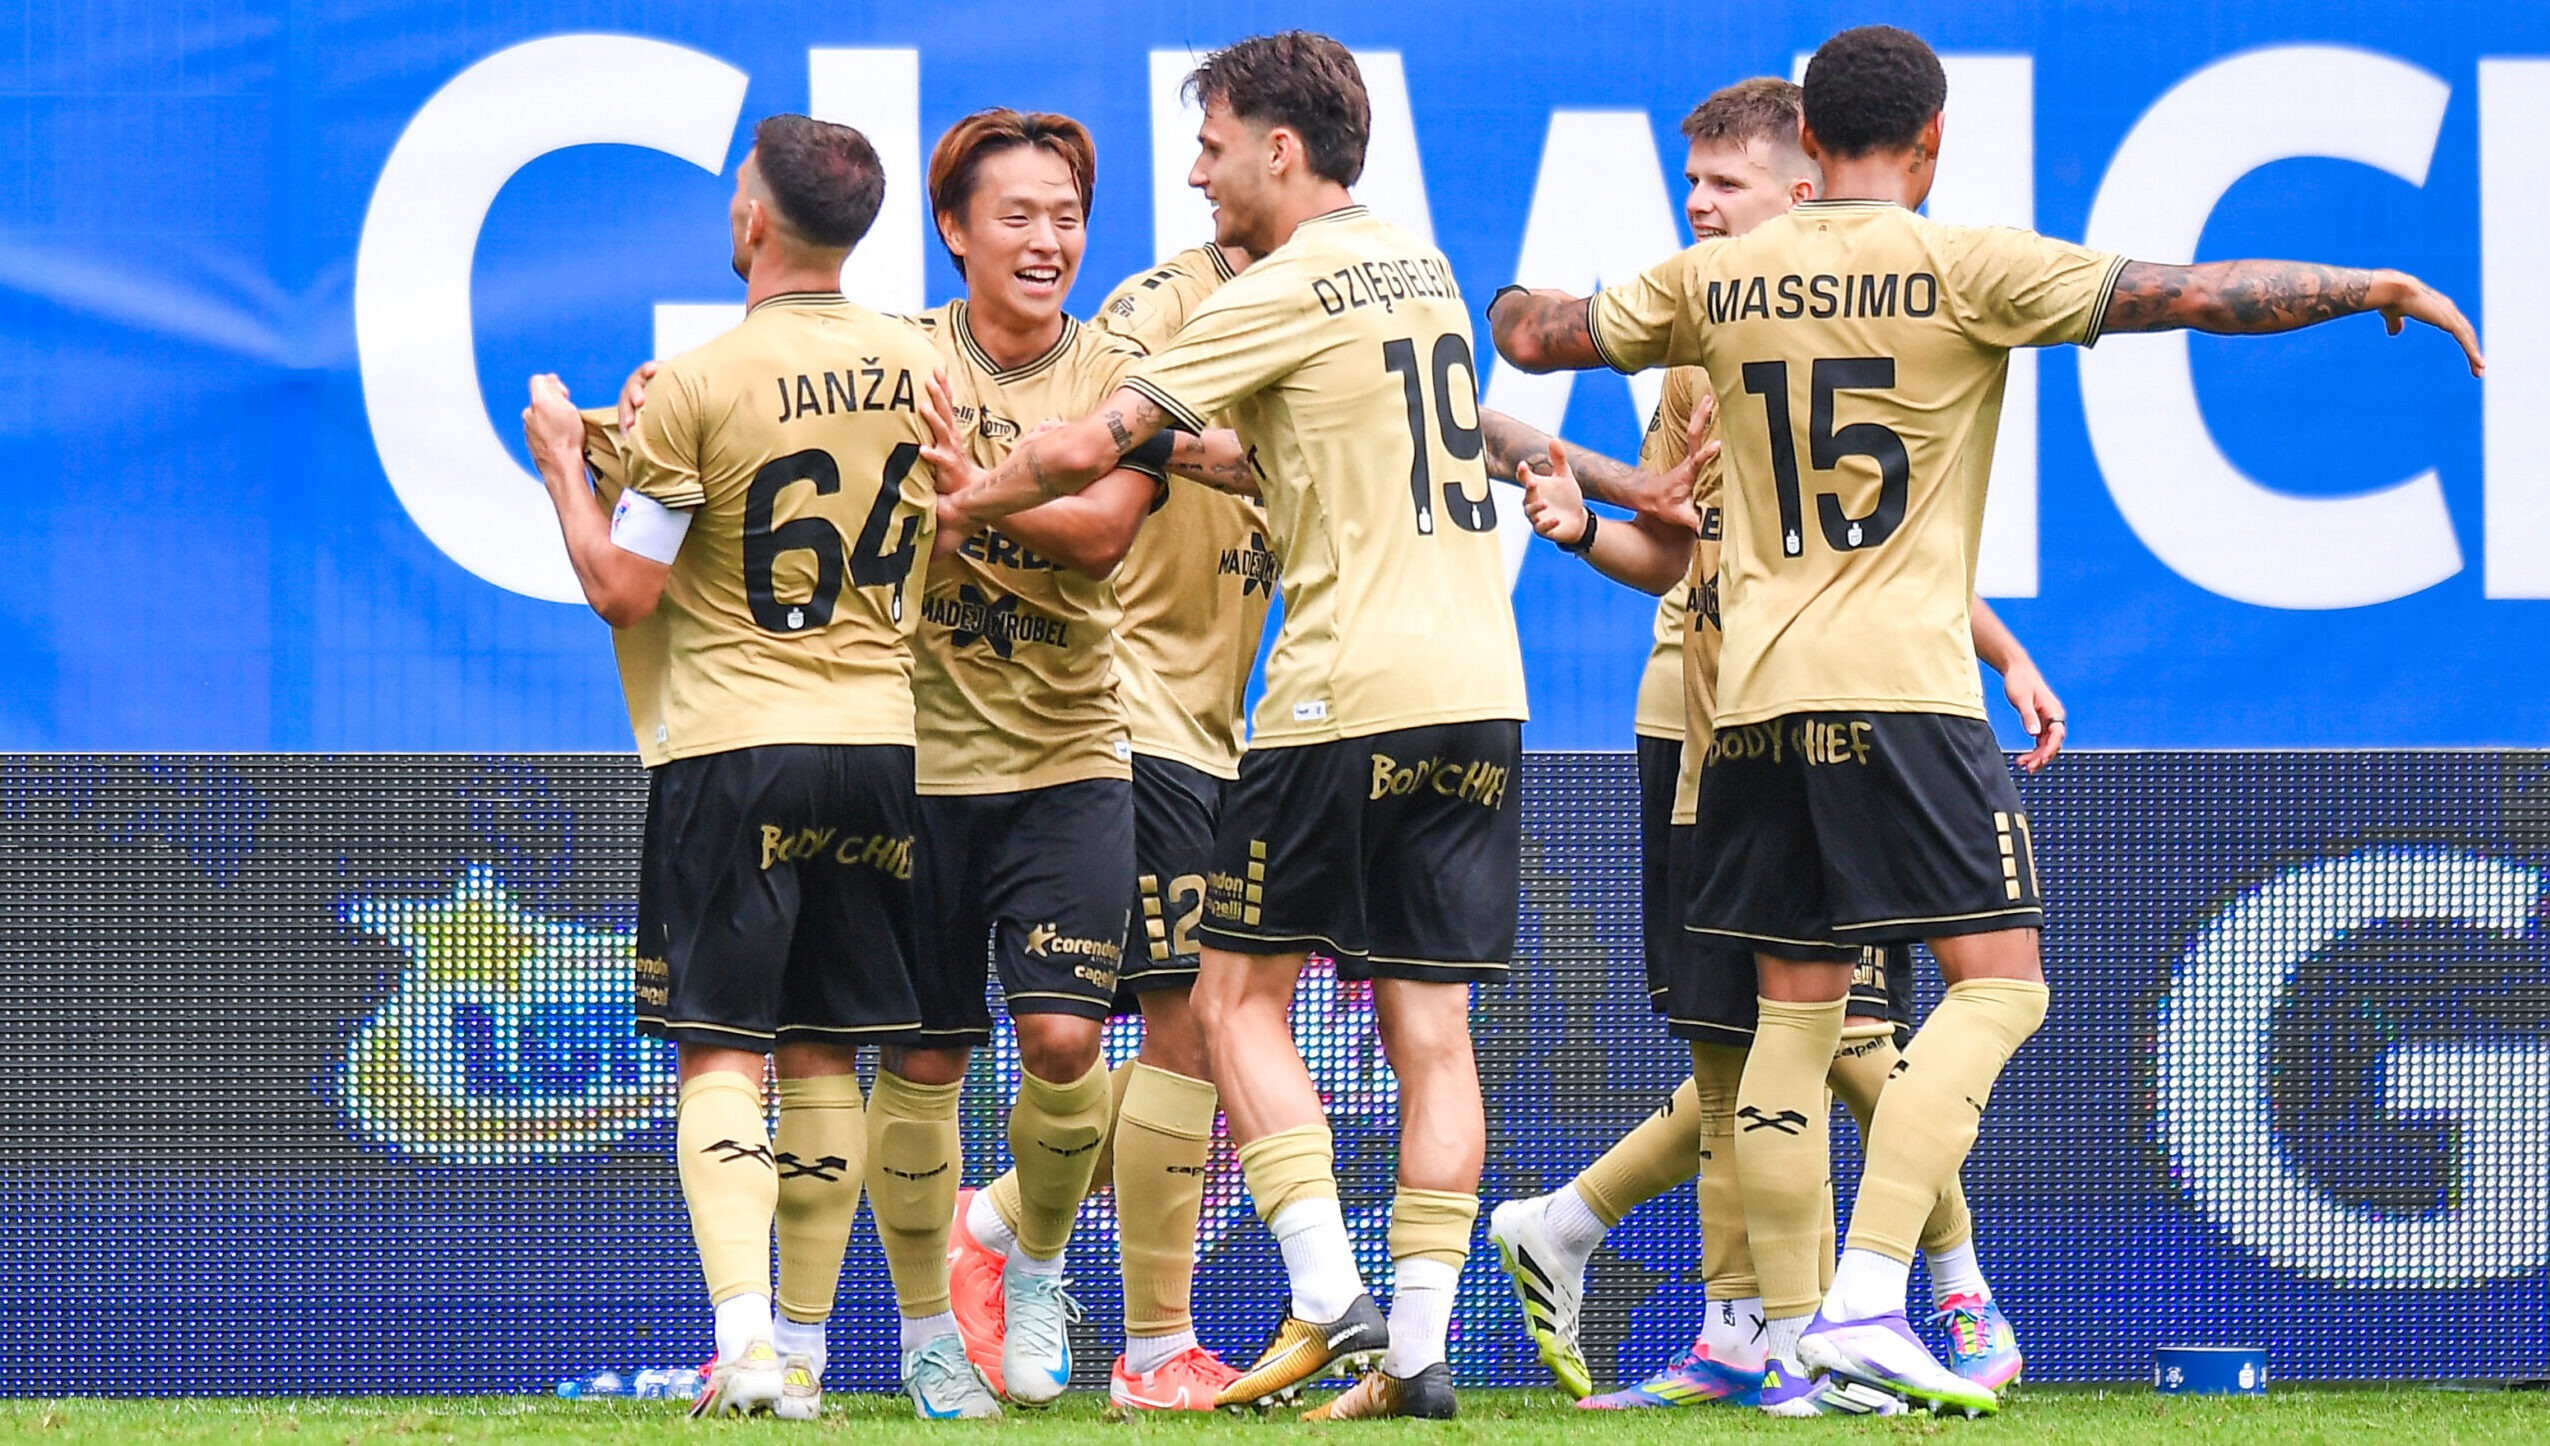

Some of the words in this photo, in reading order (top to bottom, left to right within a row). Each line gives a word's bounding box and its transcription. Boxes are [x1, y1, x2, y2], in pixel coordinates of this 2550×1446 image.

[777, 357, 916, 424] JANŽA
[1707, 272, 1937, 325] MASSIMO
[1382, 332, 1498, 536] 19
[1742, 357, 1910, 559] 15
[743, 441, 924, 633] 64
[2150, 844, 2550, 1290] G
